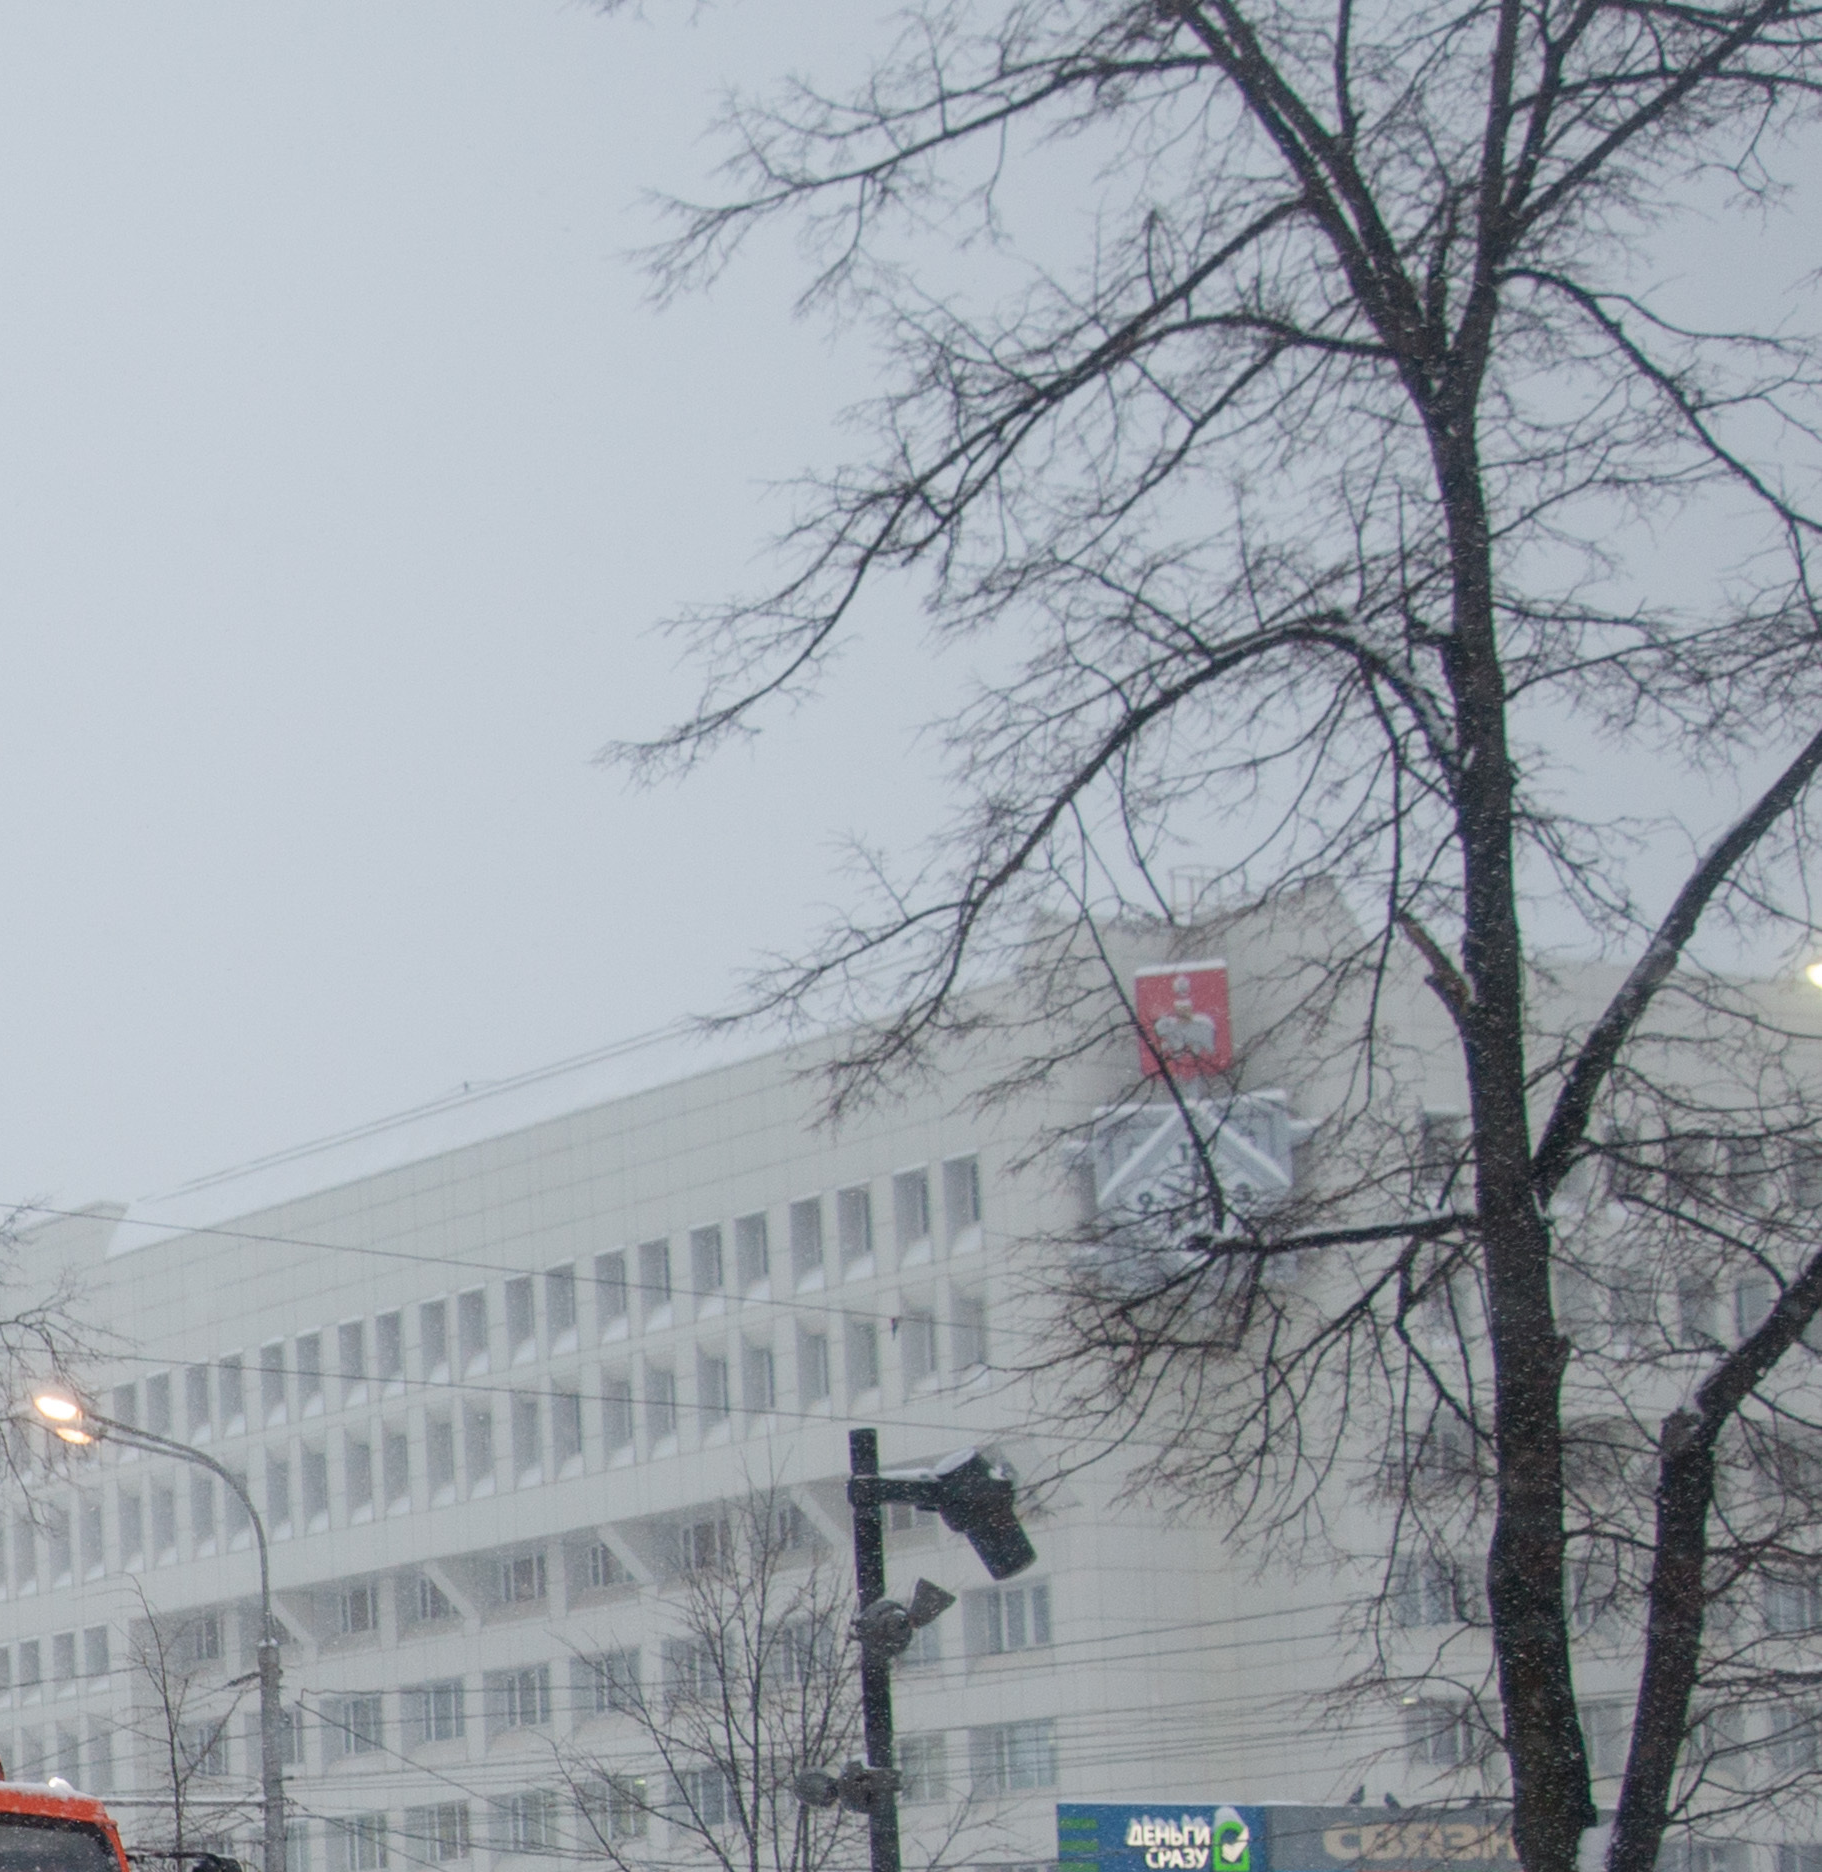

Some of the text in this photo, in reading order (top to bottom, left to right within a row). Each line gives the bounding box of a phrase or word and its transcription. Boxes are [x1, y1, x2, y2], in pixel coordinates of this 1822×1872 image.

[1126, 1820, 1212, 1847] ДЕНЬГИ
[1322, 1820, 1520, 1861] СВЯЗН
[1144, 1847, 1210, 1870] СРАЗУ
